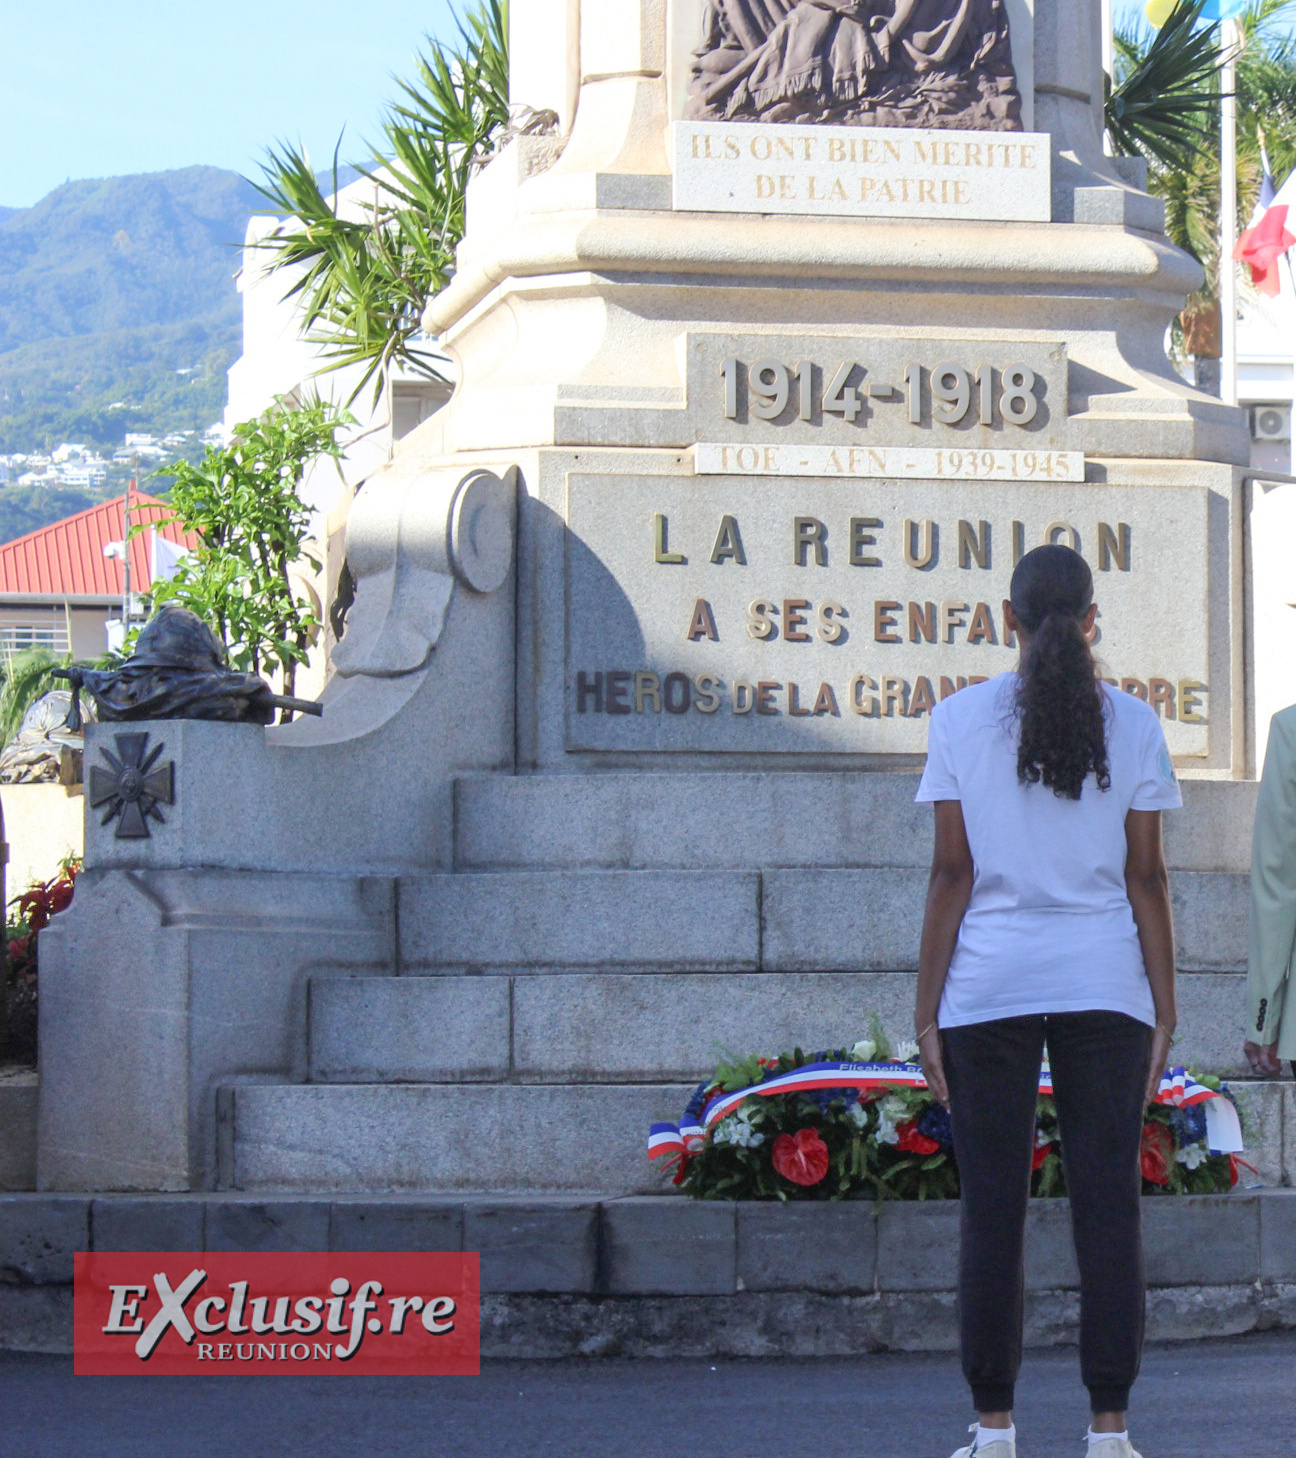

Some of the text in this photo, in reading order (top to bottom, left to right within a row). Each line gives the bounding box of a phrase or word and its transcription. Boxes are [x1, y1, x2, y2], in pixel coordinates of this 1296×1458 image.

[691, 134, 1037, 169] ILS ONT BIEN MERITE
[755, 174, 972, 204] DE LA PATRIE
[720, 357, 1039, 426] 1914-1918
[715, 445, 781, 473] TOE
[824, 448, 888, 474] AFN
[935, 450, 1071, 478] 1939-1945
[653, 513, 744, 564] LA
[687, 598, 716, 641] A
[747, 599, 843, 643] SES
[576, 671, 721, 715] HEROS
[732, 680, 780, 715] DE
[788, 682, 838, 717] LA
